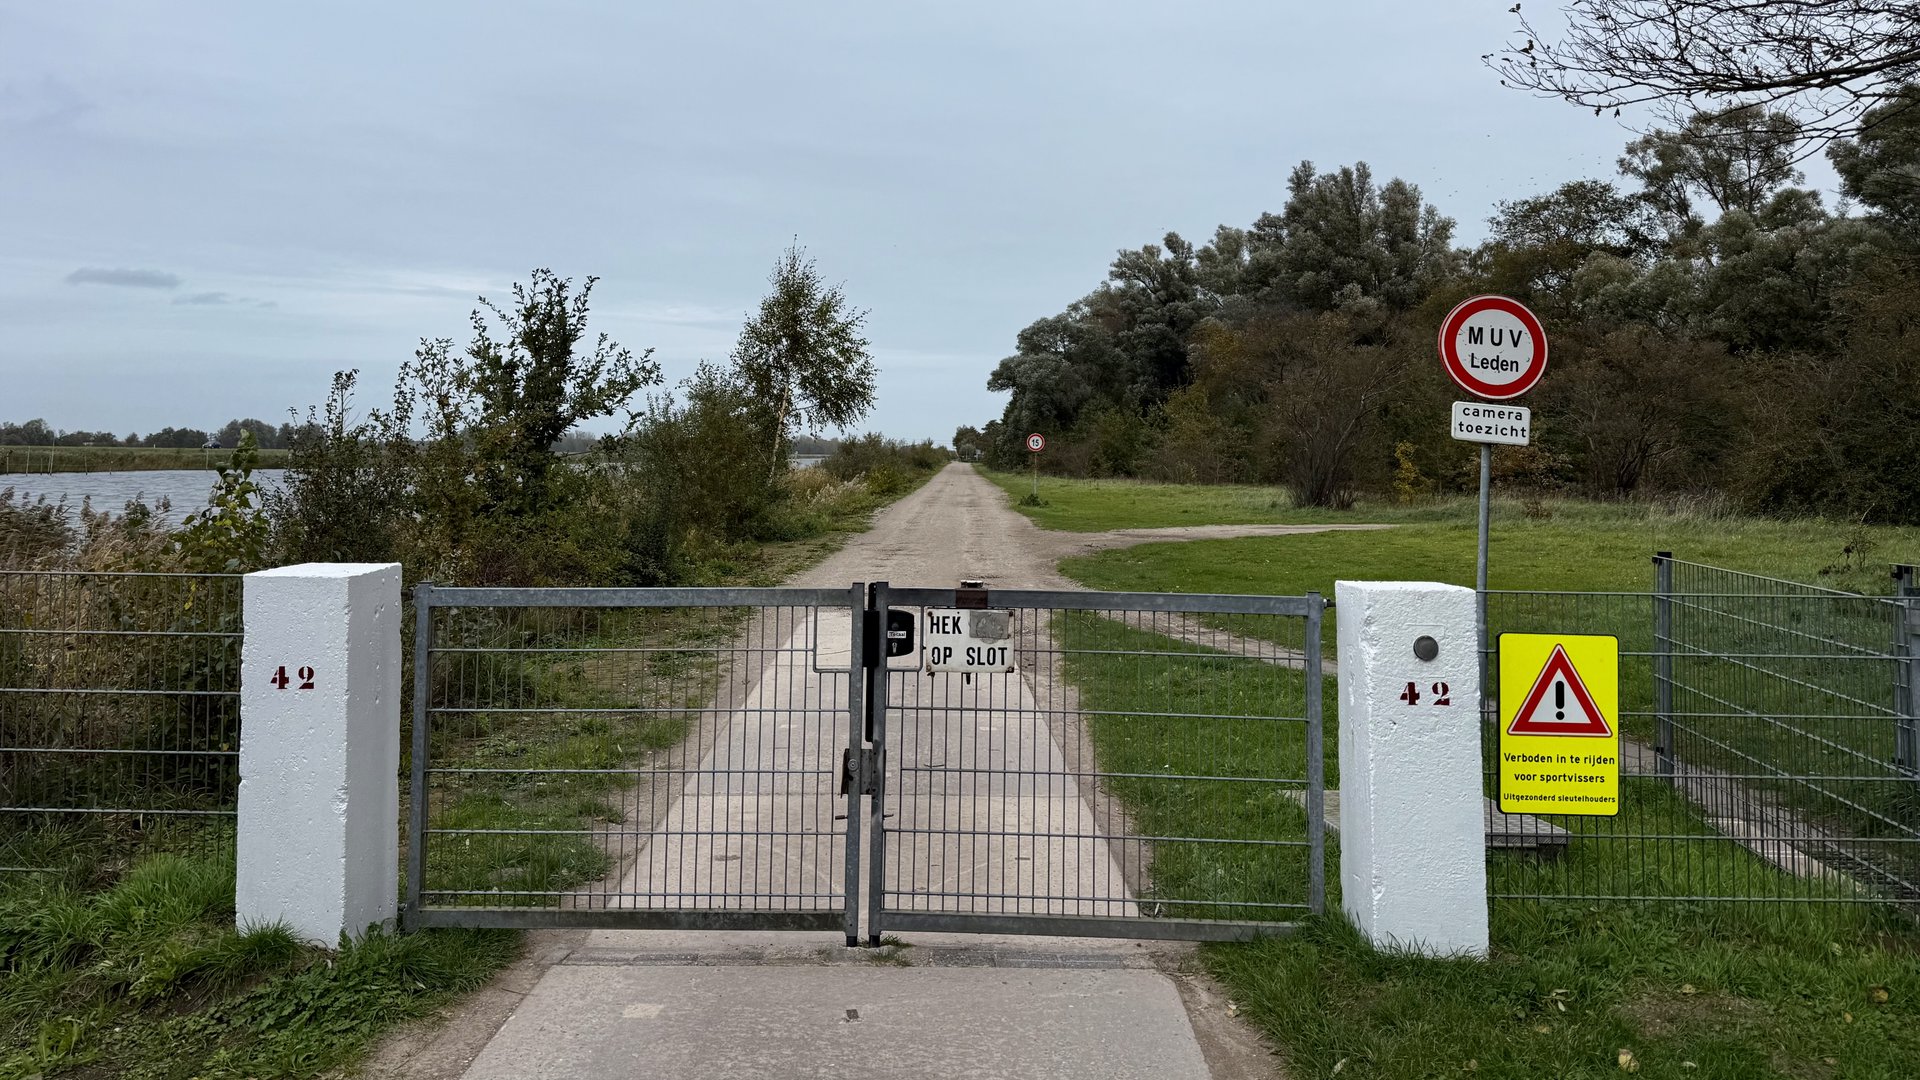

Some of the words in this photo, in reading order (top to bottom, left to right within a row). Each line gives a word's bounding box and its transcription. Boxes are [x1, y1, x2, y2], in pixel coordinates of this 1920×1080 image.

[1470, 352, 1519, 373] Leden
[1462, 407, 1523, 421] camera
[1458, 421, 1527, 438] toezicht
[1031, 439, 1040, 447] 15
[930, 615, 963, 635] HEK
[931, 646, 953, 665] OP
[966, 646, 1008, 666] SLOT
[270, 665, 315, 690] 42
[1399, 681, 1451, 706] 42
[1503, 752, 1553, 763] Verboden
[1556, 753, 1567, 764] in
[1570, 754, 1580, 764] te
[1583, 755, 1616, 767] rijden
[1514, 773, 1538, 781] voor
[1540, 773, 1605, 784] sportvissers
[1503, 792, 1556, 803] Uitgezonderd
[1558, 794, 1616, 803] sleutelhouders
